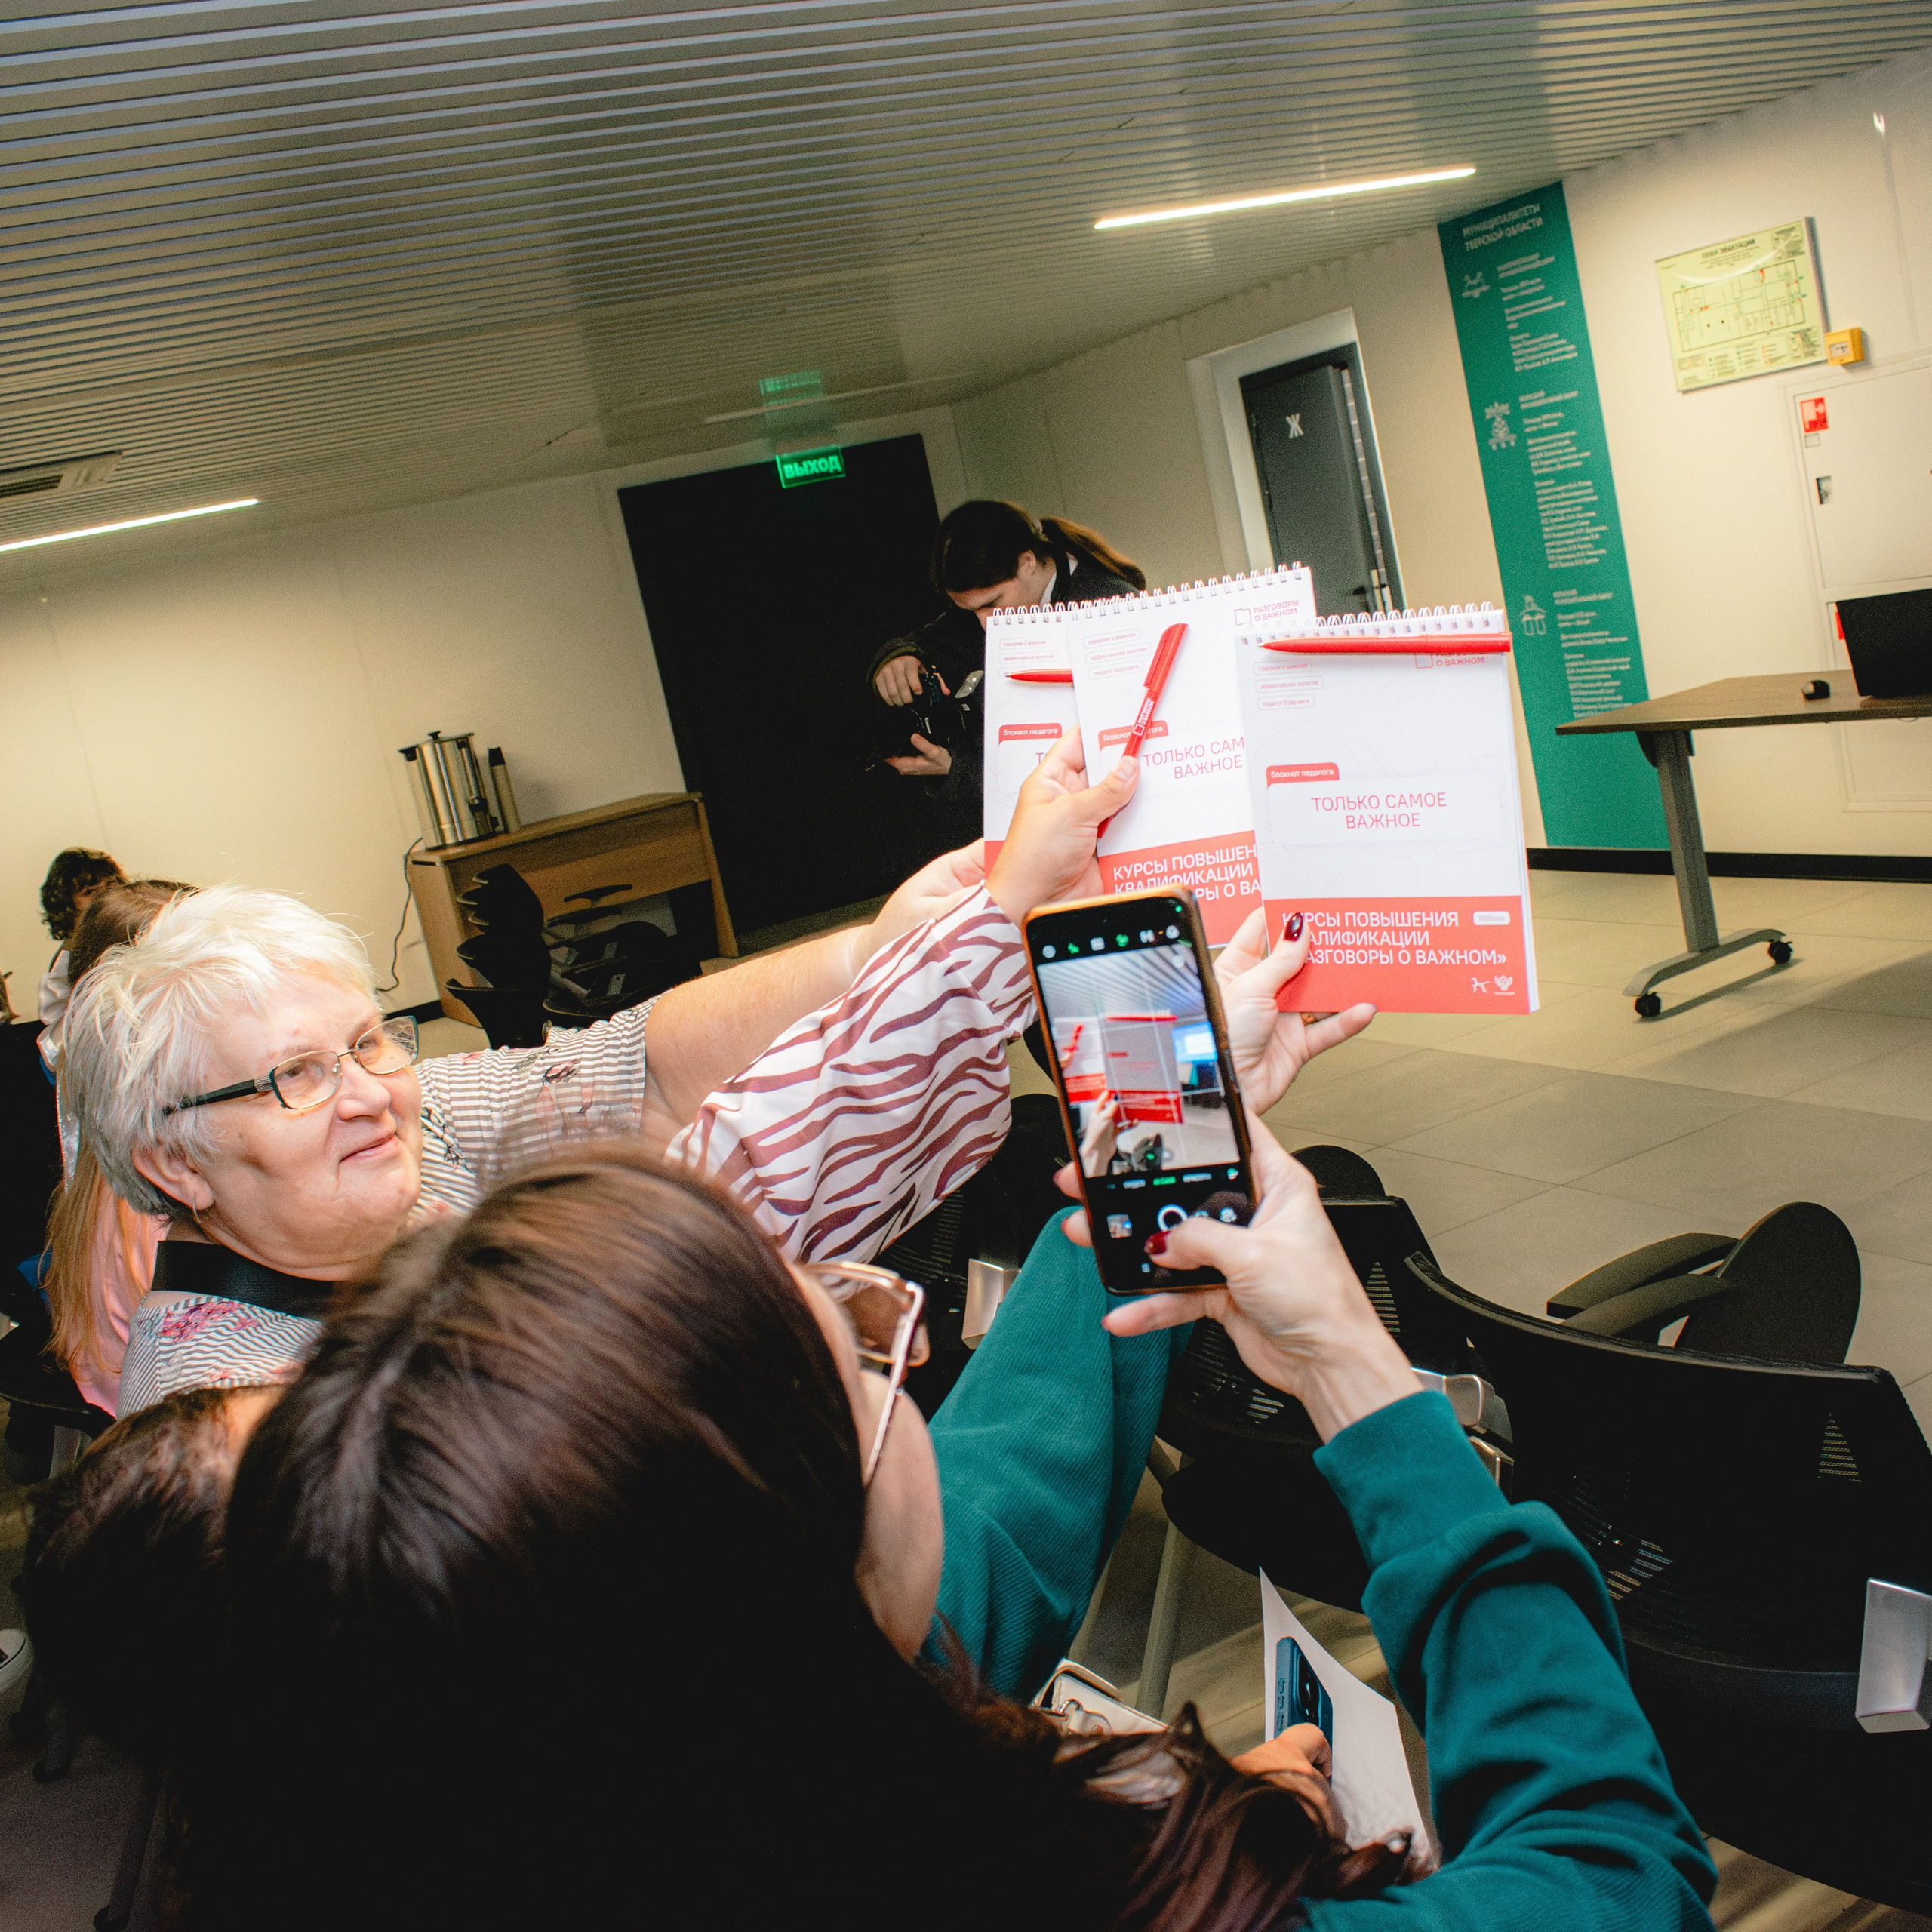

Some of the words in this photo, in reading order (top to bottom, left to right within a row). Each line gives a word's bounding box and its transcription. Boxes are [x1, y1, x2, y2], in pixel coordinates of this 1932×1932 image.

[1285, 413, 1304, 439] Ж
[783, 455, 842, 479] ВЫХОД
[1254, 600, 1300, 614] РАЗГОВОРЫ
[1262, 608, 1298, 621] ВАЖНОМ
[1445, 657, 1485, 666] ВАЖНОМ
[1103, 731, 1131, 741] блокнот
[1143, 744, 1205, 768] ТОЛЬКО
[1210, 737, 1244, 755] САМ
[1174, 755, 1243, 779] ВАЖНОЕ
[1271, 770, 1300, 778] блокнот
[1301, 768, 1334, 777] педагога
[1312, 795, 1380, 811] ТОЛЬКО
[1385, 792, 1447, 808] САМОЕ
[1346, 813, 1421, 829] ВАЖНОЕ
[1113, 858, 1168, 881] КУРСЫ
[1171, 844, 1257, 870] ПОВЫШЕН
[1282, 912, 1340, 928] КРСЫ
[1345, 911, 1459, 927] ПОВЫШЕНИЯ
[1309, 931, 1429, 948] АЛИФИКАЦИИ
[1305, 949, 1394, 965] АЗГОВОРЫ
[1398, 949, 1411, 964] О
[1416, 949, 1506, 965] ВАЖНОМ»
